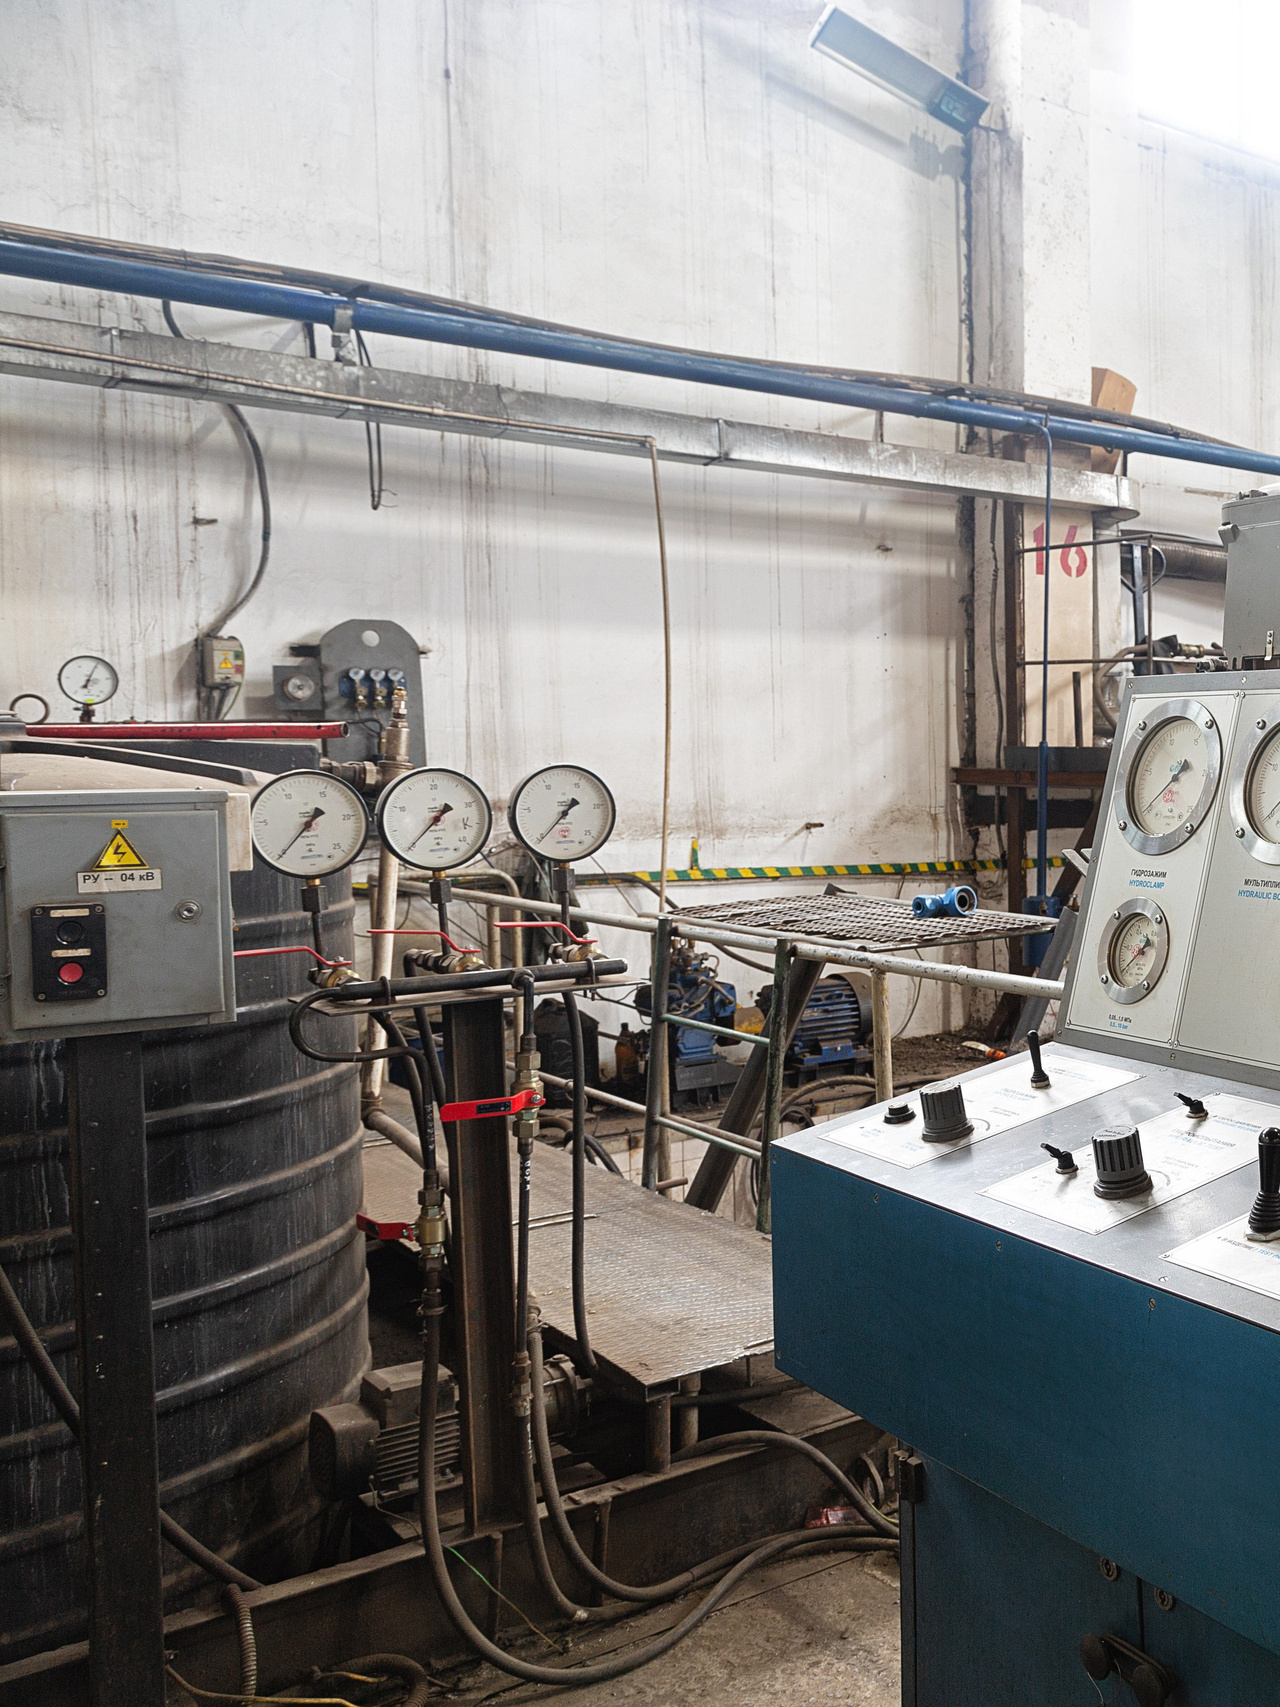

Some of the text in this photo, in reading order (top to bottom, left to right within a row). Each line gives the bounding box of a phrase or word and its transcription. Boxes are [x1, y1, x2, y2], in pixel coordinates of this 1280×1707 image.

[1033, 522, 1087, 578] 16
[1271, 763, 1278, 771] 10
[83, 874, 100, 883] РУ
[120, 873, 135, 882] 04
[139, 872, 155, 881] кВ
[1130, 869, 1167, 878] ГИДРОЗАЖИМ
[1128, 879, 1165, 889] HYDROCLAMP
[1237, 889, 1272, 900] HYDRAULIC
[1257, 1248, 1274, 1257] TEST
